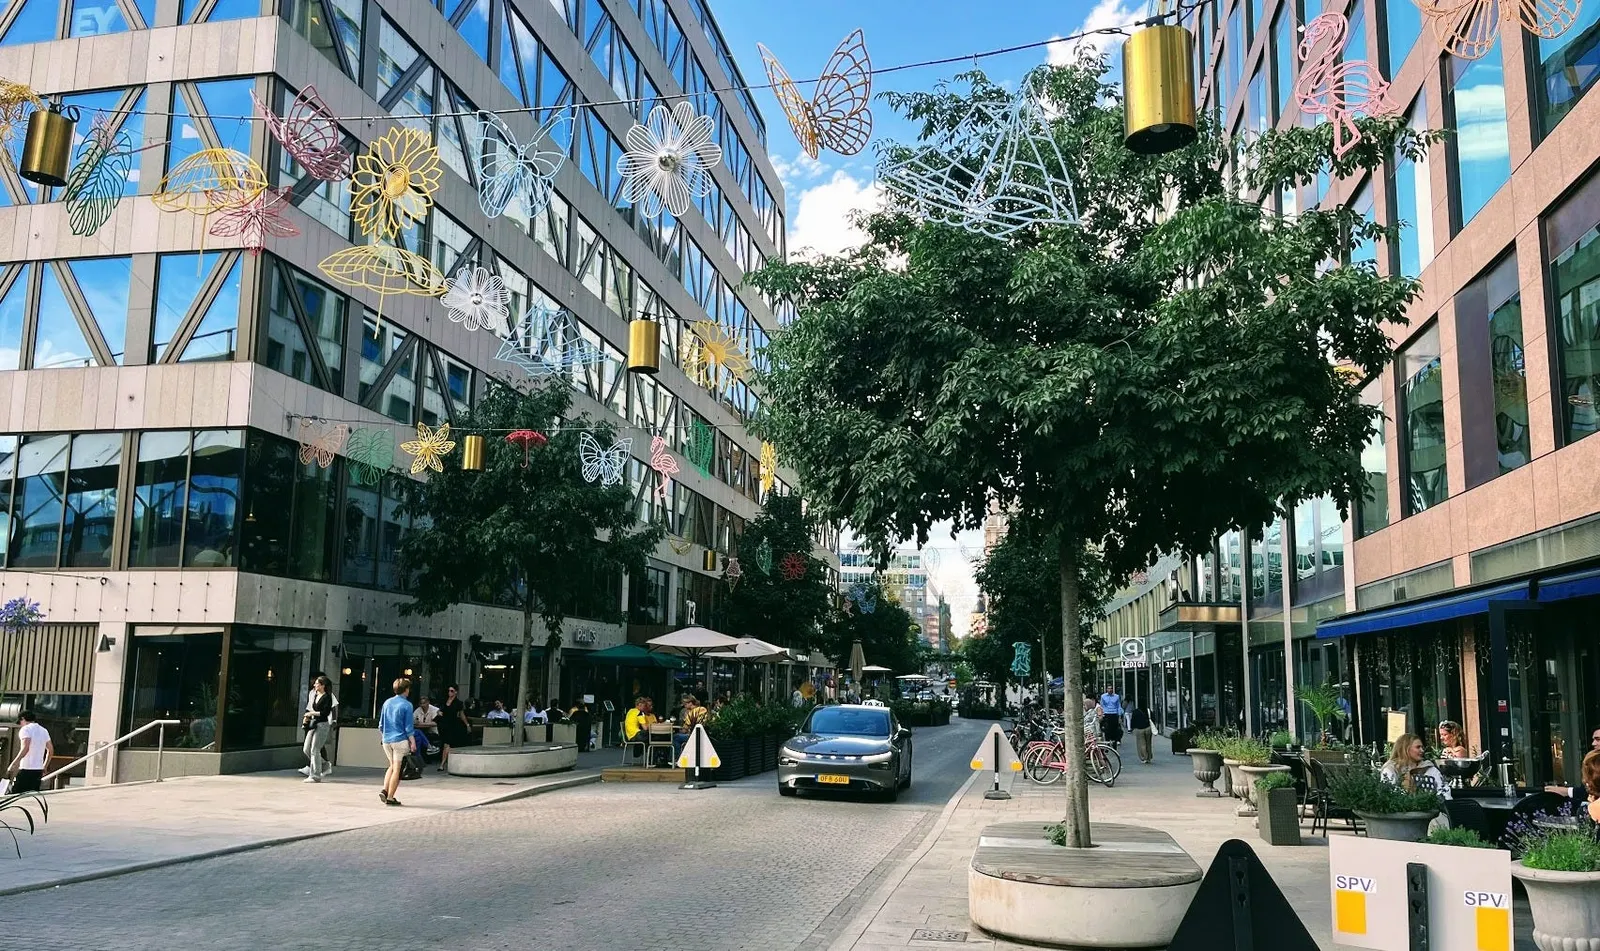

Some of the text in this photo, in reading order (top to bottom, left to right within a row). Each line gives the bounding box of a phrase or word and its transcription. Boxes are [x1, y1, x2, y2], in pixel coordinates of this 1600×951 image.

[75, 5, 118, 37] EY
[1336, 875, 1371, 892] SPV
[1465, 891, 1503, 908] SPV
